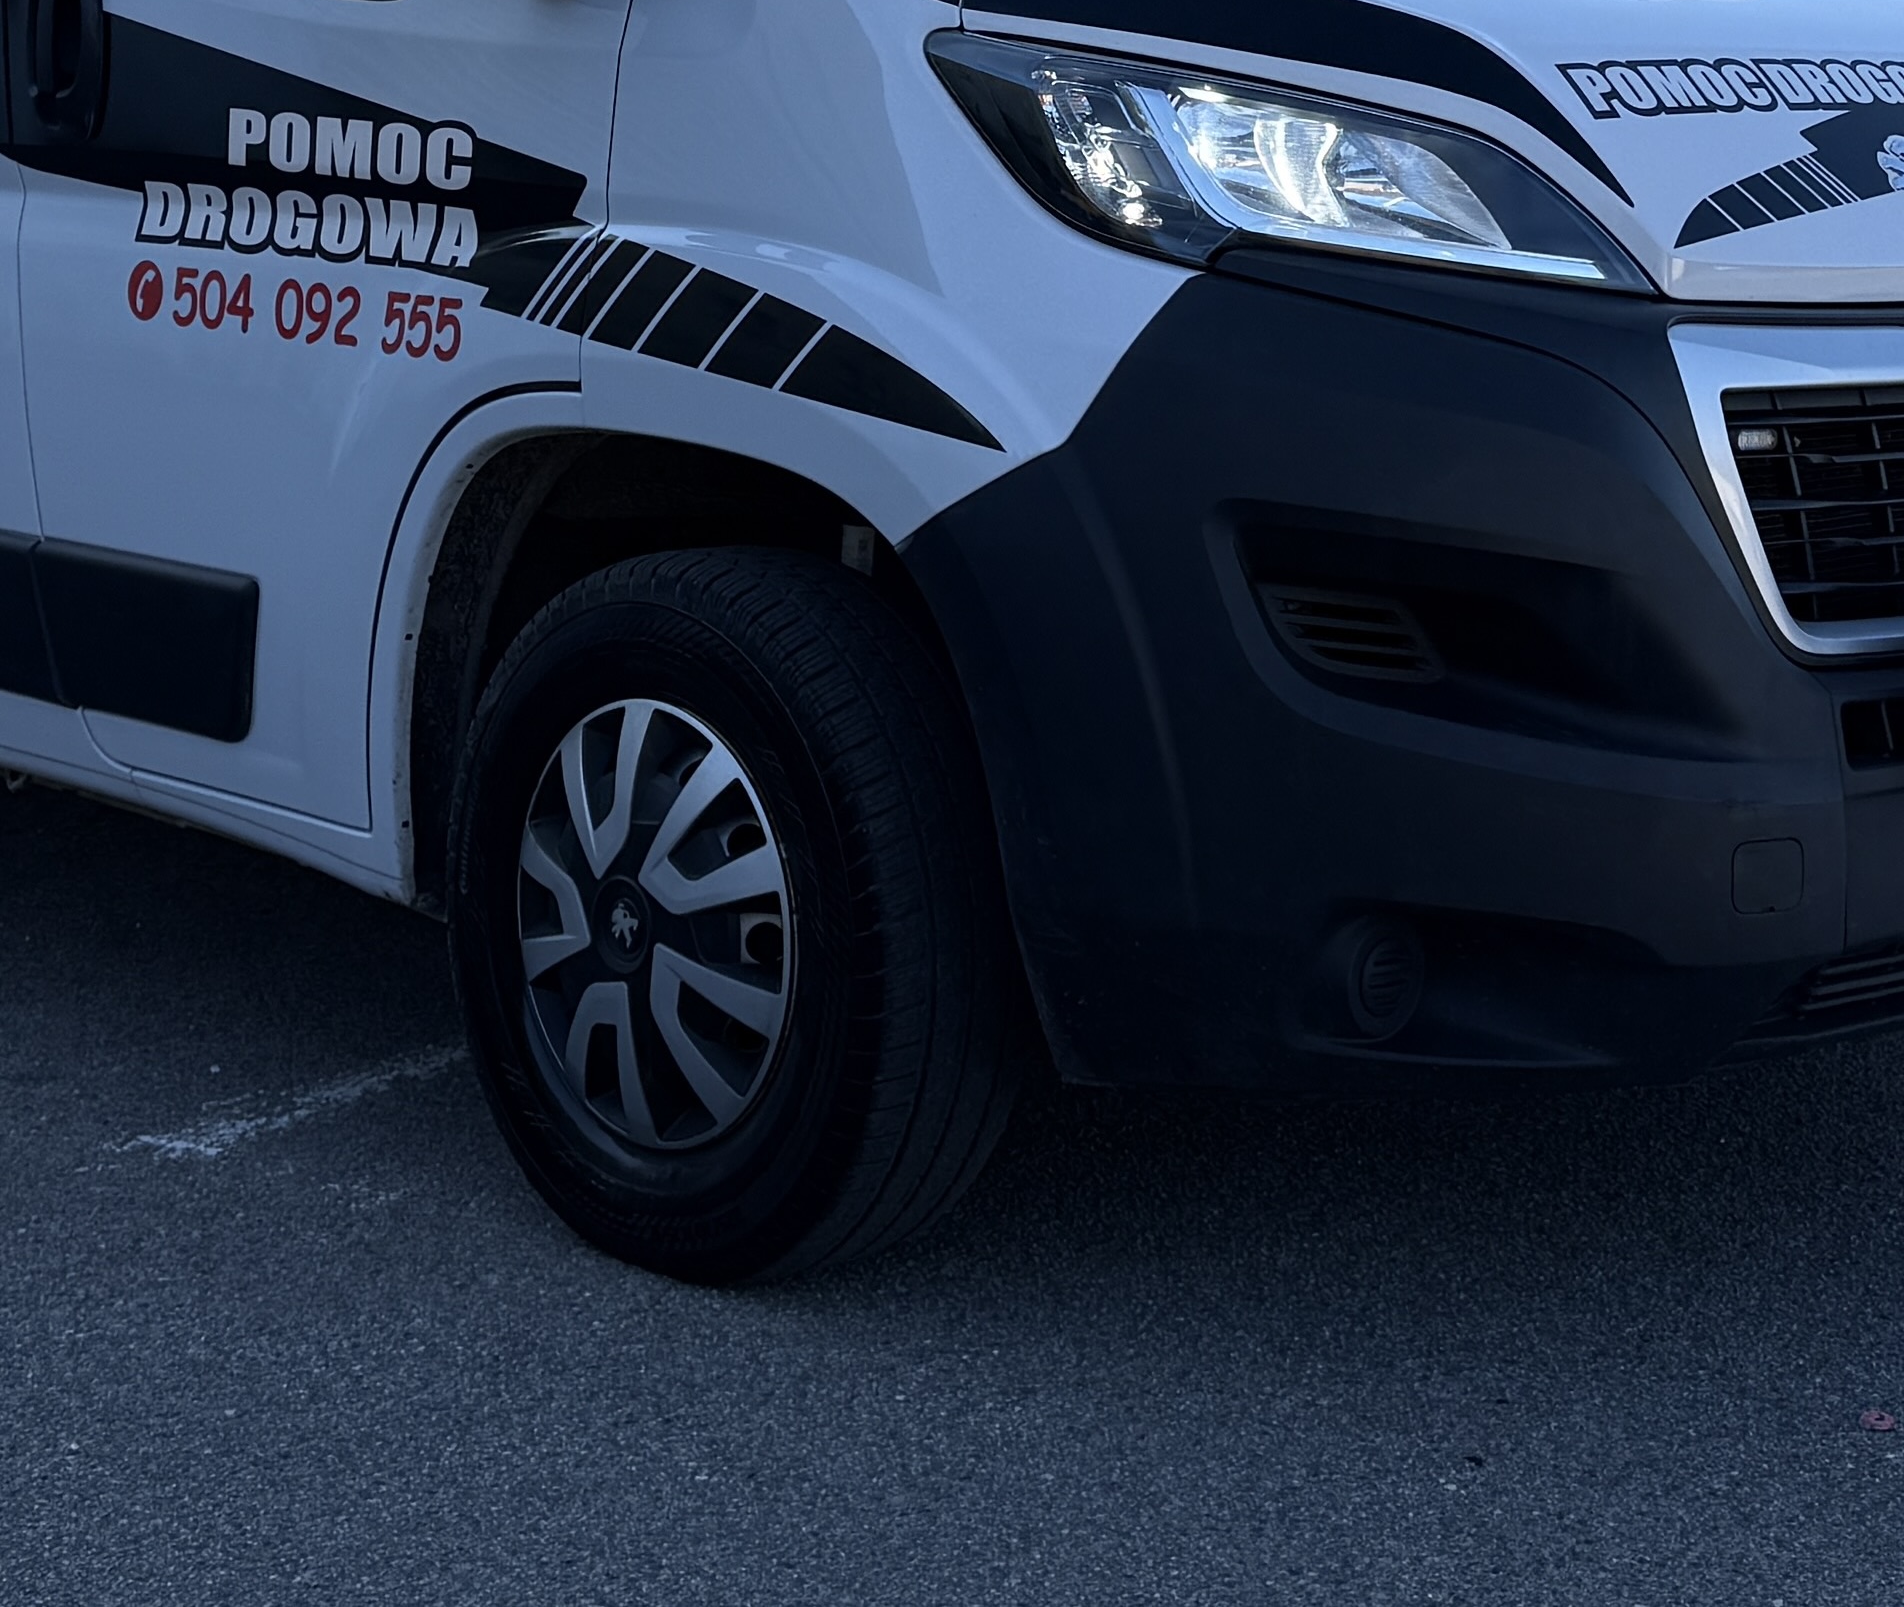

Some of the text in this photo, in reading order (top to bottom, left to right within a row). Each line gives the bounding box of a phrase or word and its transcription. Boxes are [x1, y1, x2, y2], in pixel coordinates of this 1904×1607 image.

[1561, 61, 1779, 116] POMOC
[227, 107, 474, 190] POMOC
[139, 180, 478, 270] DROGOWA
[172, 269, 464, 362] 504 092 555
